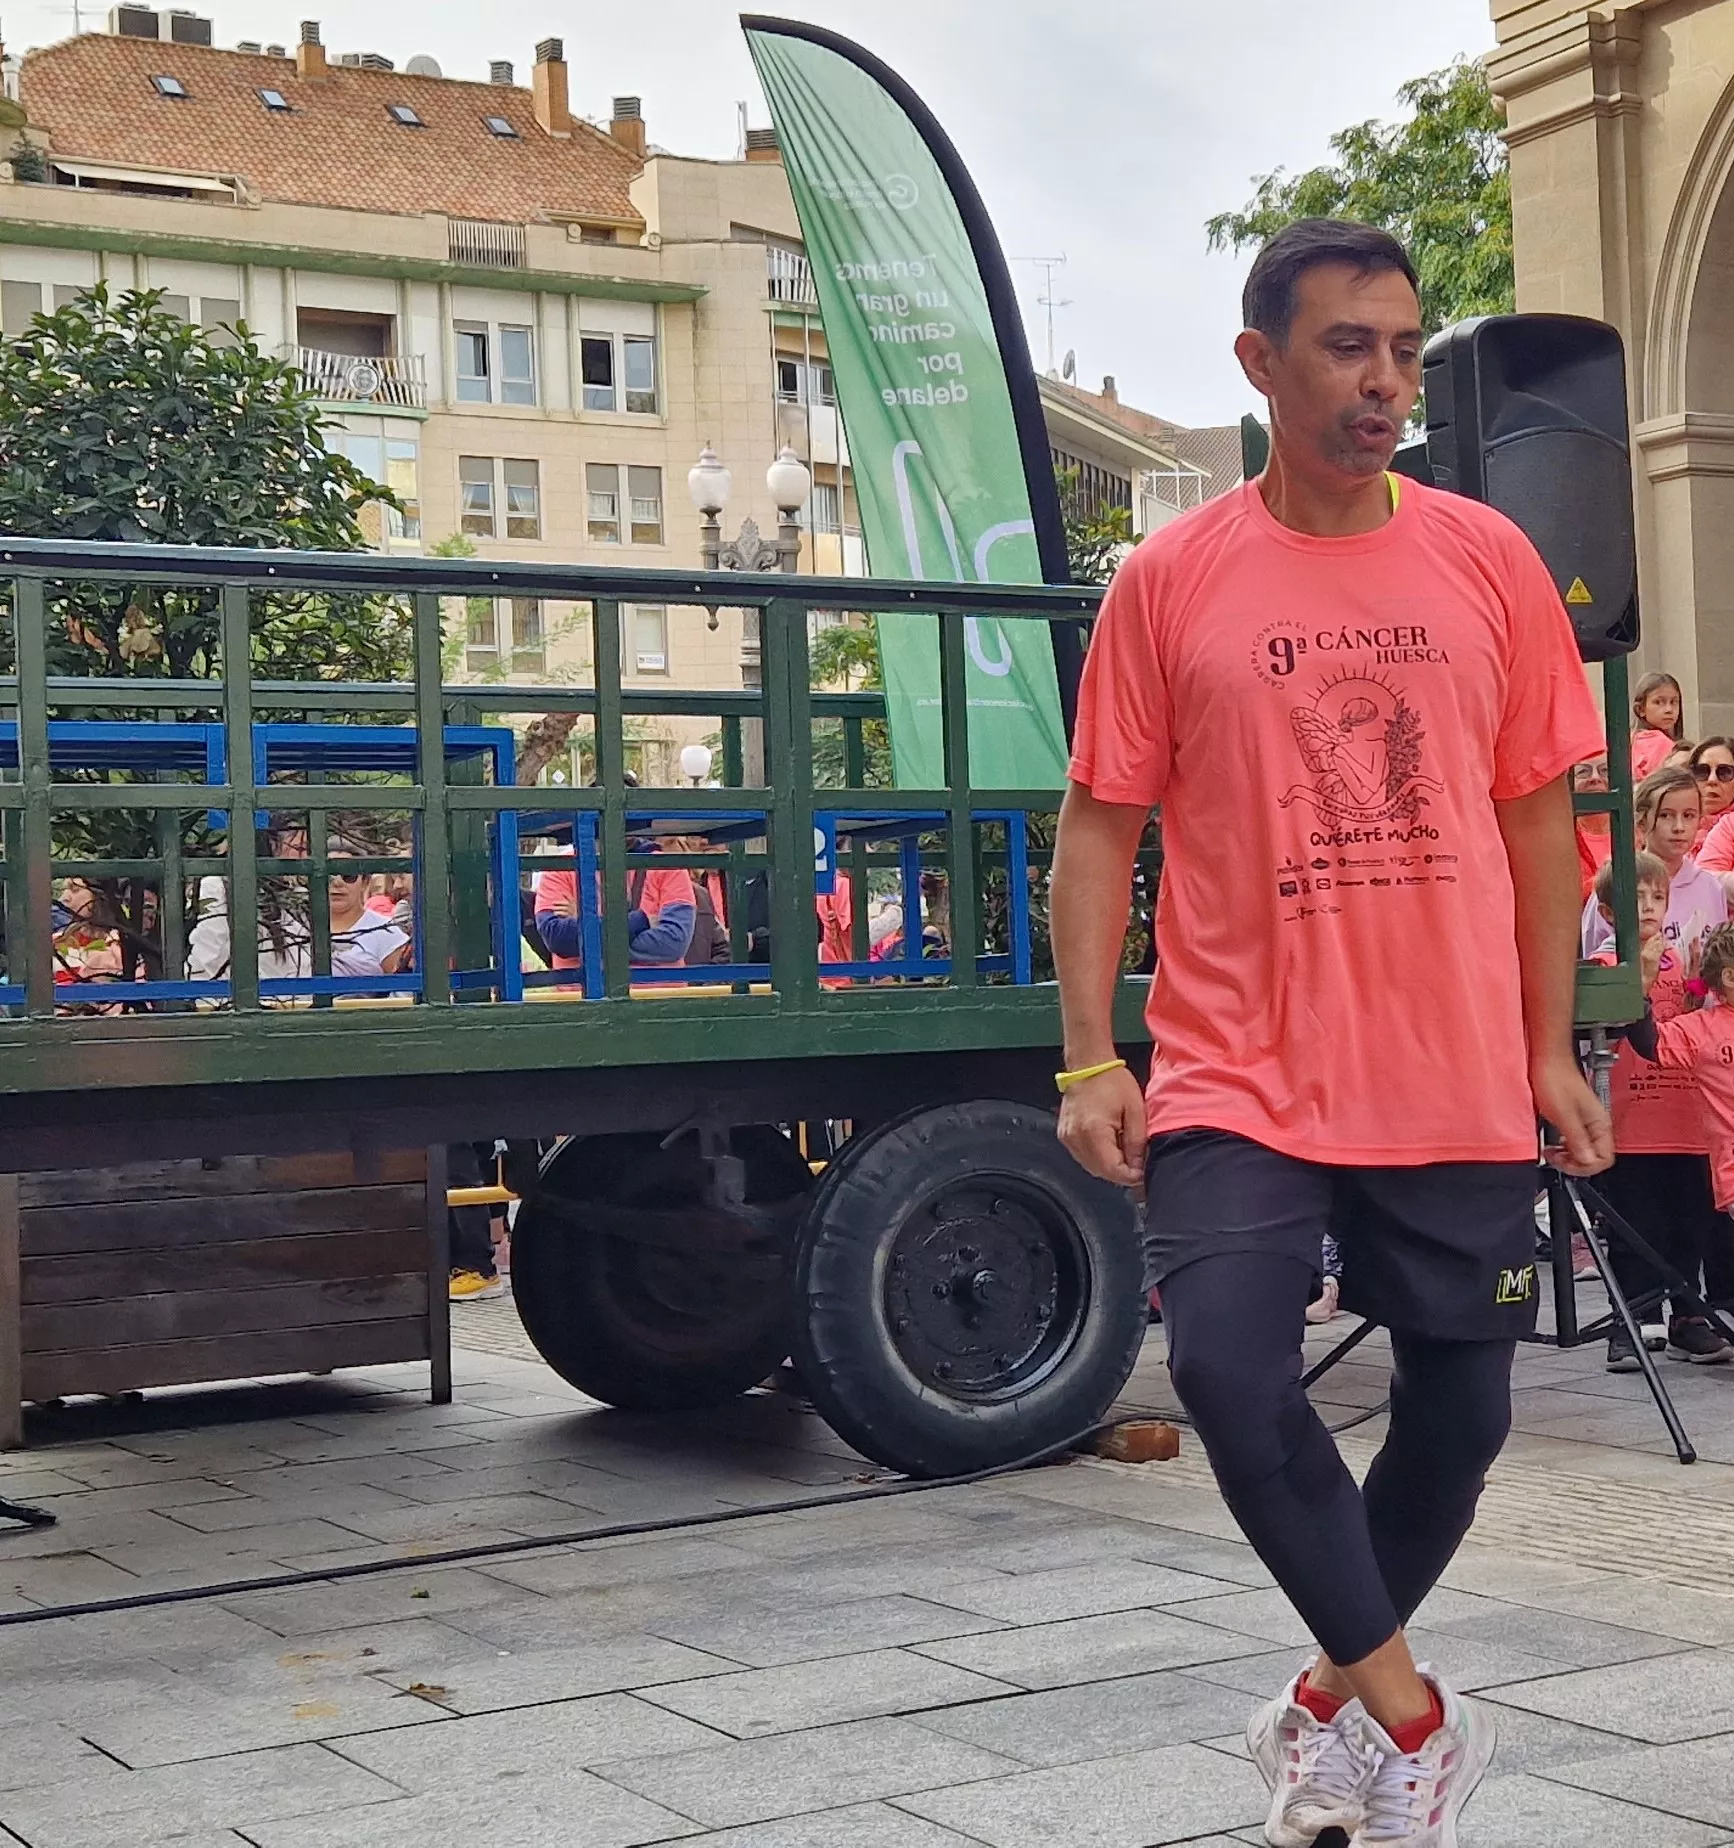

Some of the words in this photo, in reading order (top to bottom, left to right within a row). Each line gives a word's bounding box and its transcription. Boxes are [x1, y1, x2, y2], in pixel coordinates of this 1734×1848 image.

[1252, 620, 1293, 648] CONTRA
[1296, 620, 1308, 633] EL
[1315, 625, 1428, 651] CÁNCER
[1376, 649, 1450, 665] HUESCA
[1387, 824, 1440, 844] MUCHO
